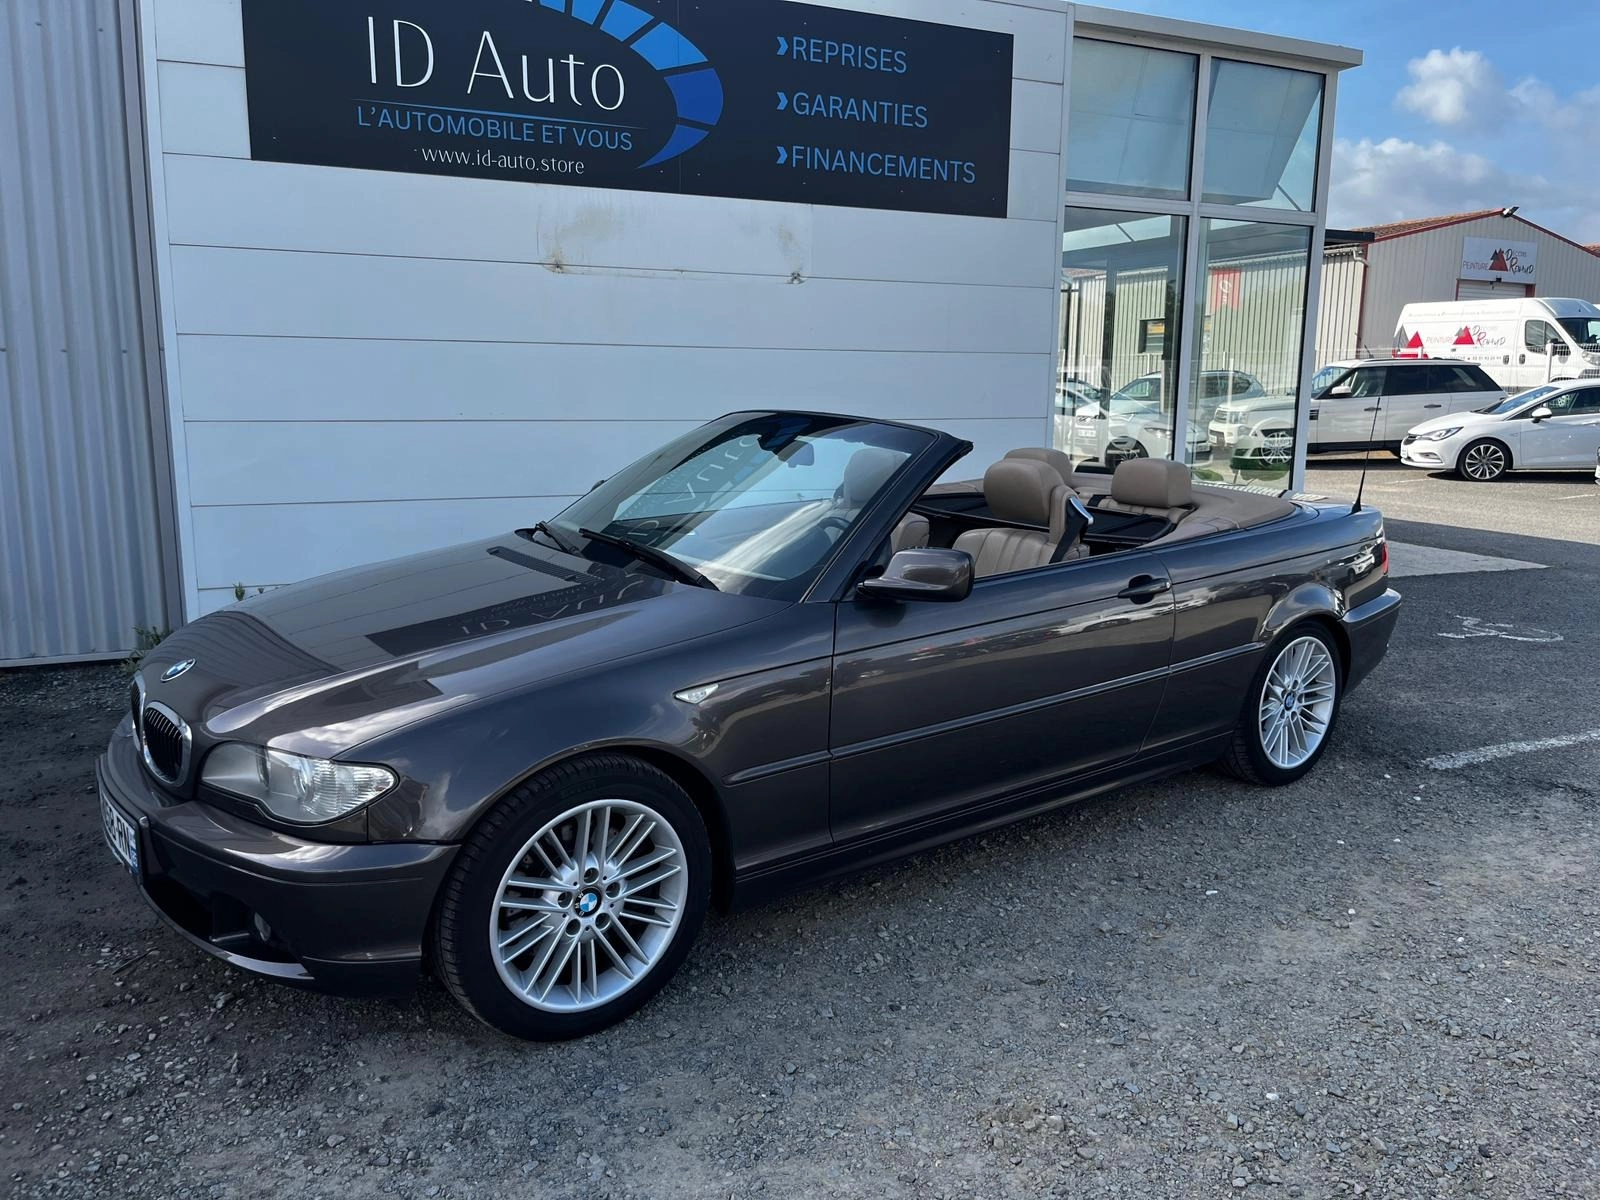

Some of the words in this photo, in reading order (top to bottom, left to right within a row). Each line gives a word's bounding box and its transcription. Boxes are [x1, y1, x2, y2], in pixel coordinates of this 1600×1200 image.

[367, 16, 434, 88] ID
[466, 30, 625, 110] Auto
[792, 36, 907, 74] REPRISES
[357, 105, 535, 142] L'AUTOMOBILE
[542, 124, 566, 145] ET
[573, 127, 633, 151] VOUS
[792, 92, 928, 129] GARANTIES
[421, 148, 585, 175] www.id-auto.store
[792, 145, 976, 184] FINANCEMENTS
